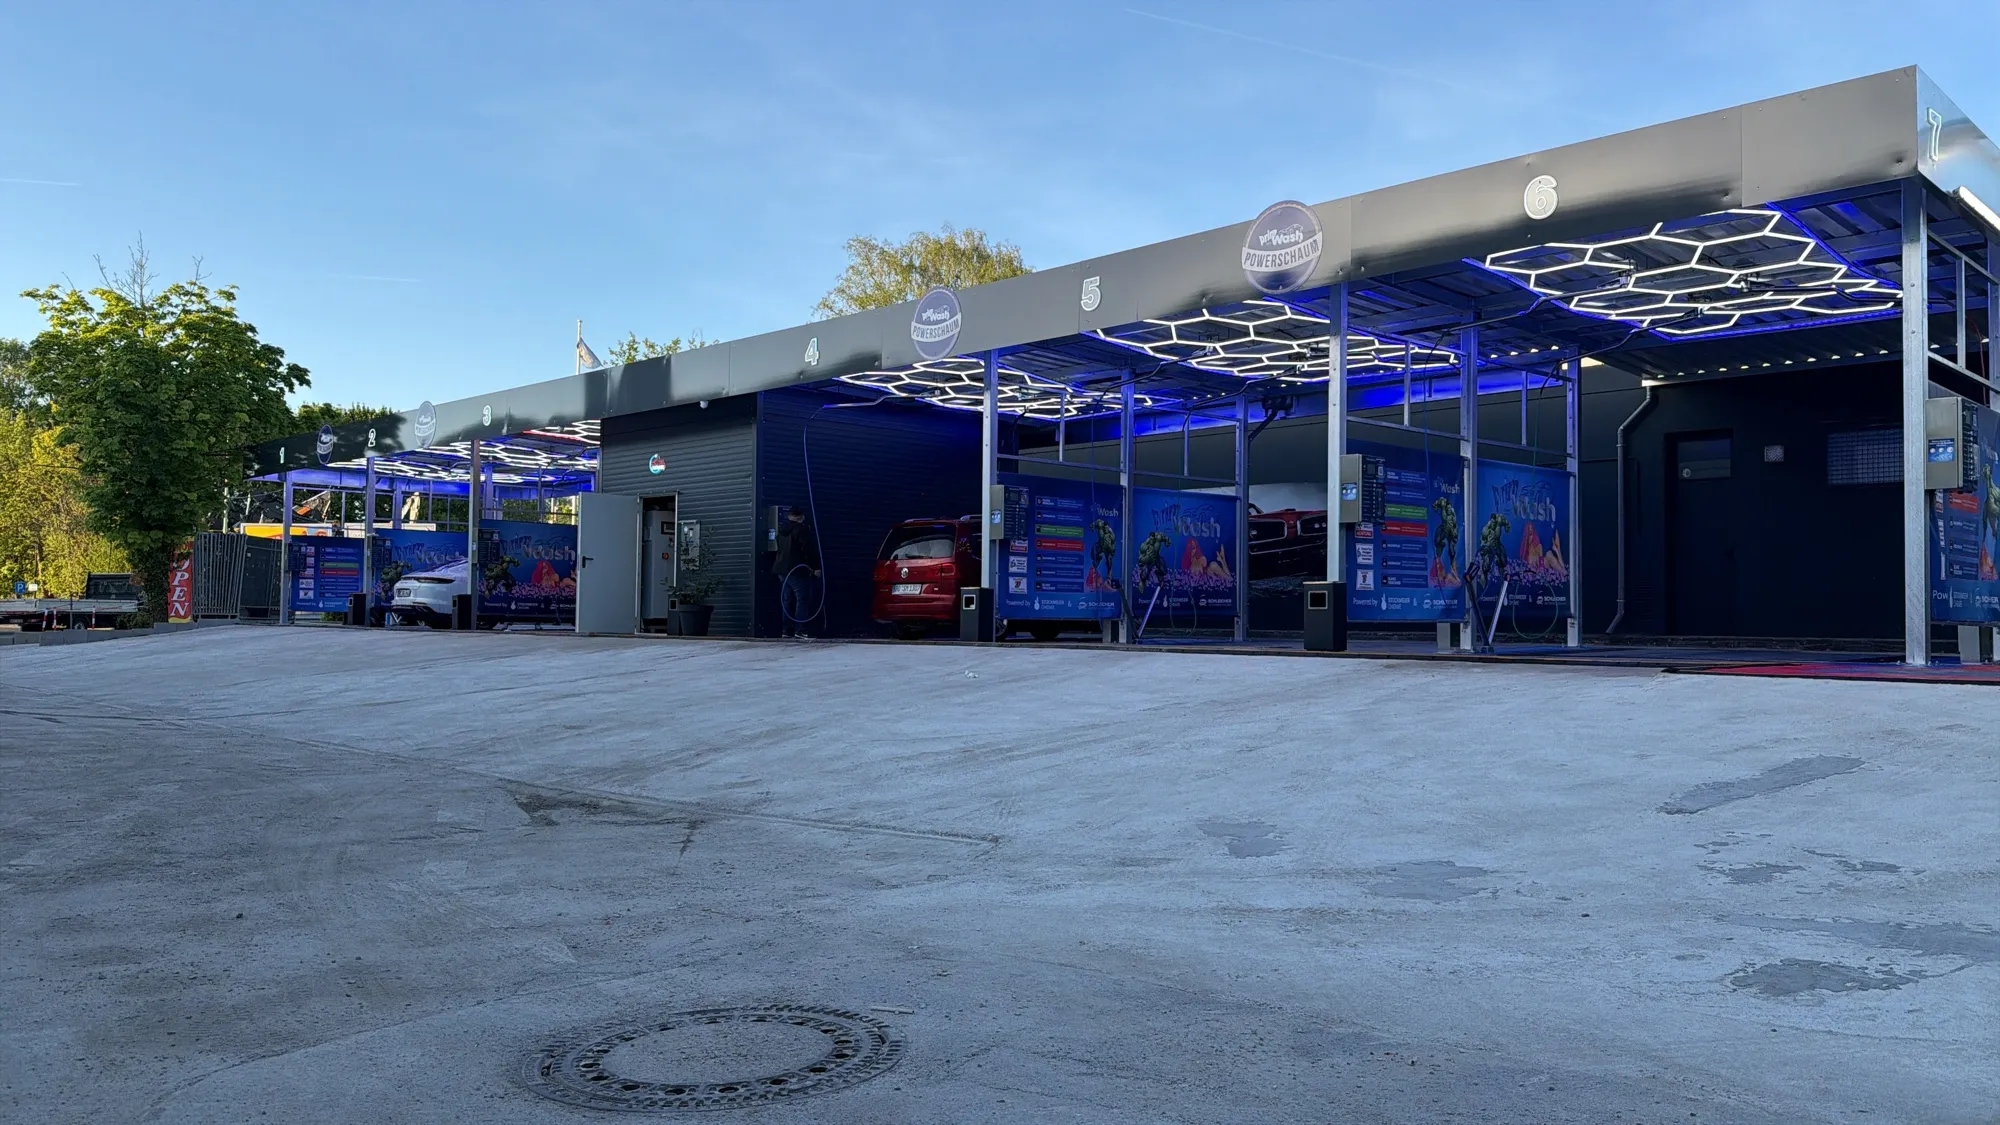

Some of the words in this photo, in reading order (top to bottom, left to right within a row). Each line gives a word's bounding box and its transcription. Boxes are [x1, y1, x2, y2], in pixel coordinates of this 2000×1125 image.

[1927, 107, 1942, 162] 7
[1523, 174, 1558, 220] 6
[1272, 230, 1304, 246] Wash
[1243, 238, 1320, 268] POWERSCHAUM
[1081, 276, 1101, 311] 5
[912, 318, 960, 339] POWERSCHAUM
[804, 337, 819, 366] 4
[482, 404, 492, 427] 3
[367, 428, 377, 447] 2
[279, 446, 285, 464] 1
[1440, 483, 1461, 494] Wash
[1097, 507, 1119, 518] Wash
[1511, 496, 1556, 522] Wash
[1173, 516, 1221, 538] Wash
